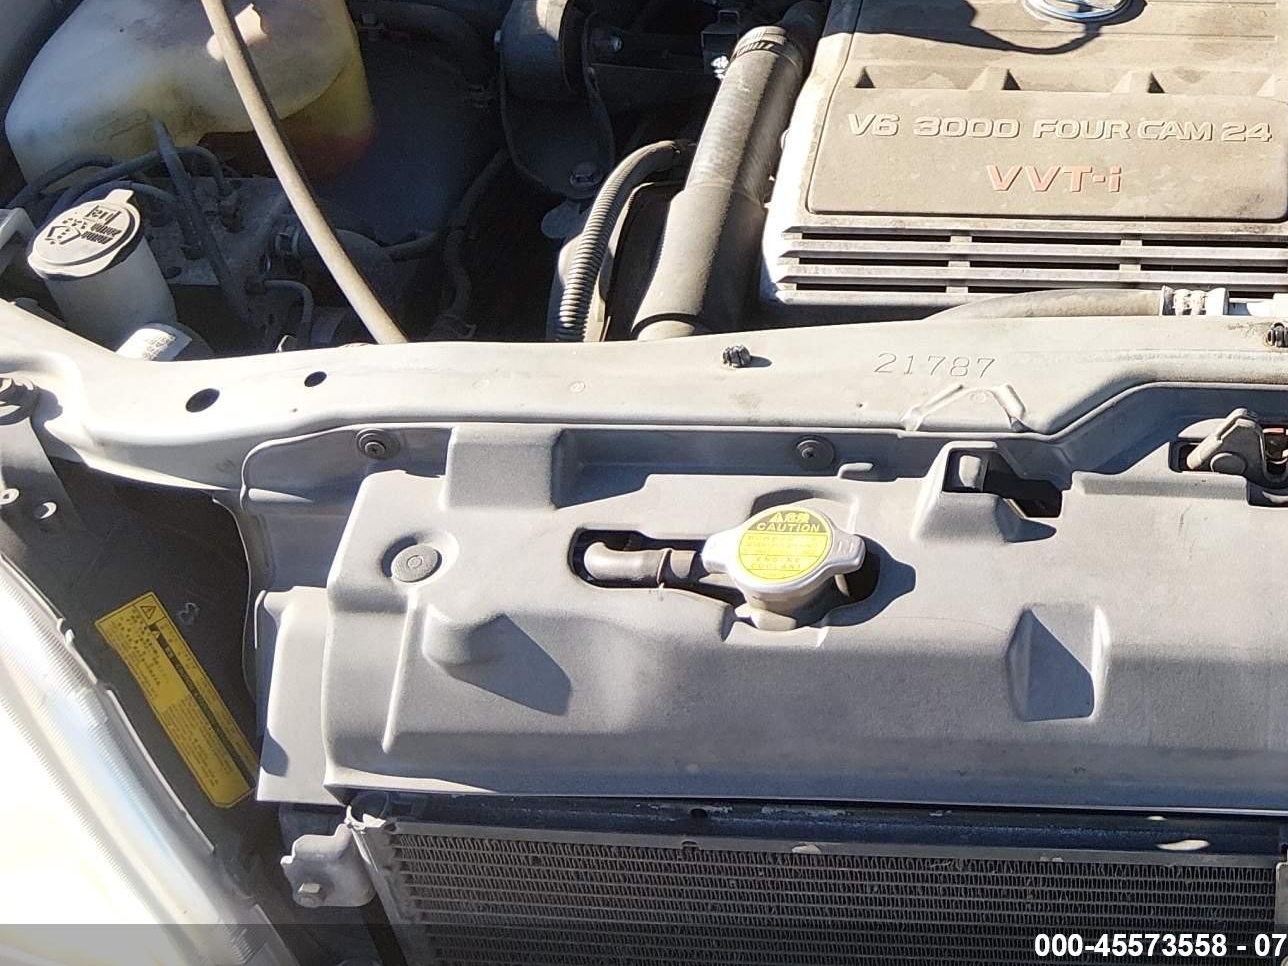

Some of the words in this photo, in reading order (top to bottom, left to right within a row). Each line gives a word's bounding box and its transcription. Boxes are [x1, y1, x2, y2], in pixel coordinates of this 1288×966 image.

[848, 113, 900, 136] V6
[913, 116, 1020, 139] 3000
[1032, 119, 1130, 140] FOUR
[1137, 120, 1215, 141] CAM
[1220, 121, 1273, 143] 24
[986, 164, 1122, 192] VVT-i
[873, 352, 997, 379] 21787
[756, 522, 820, 532] CAUTION
